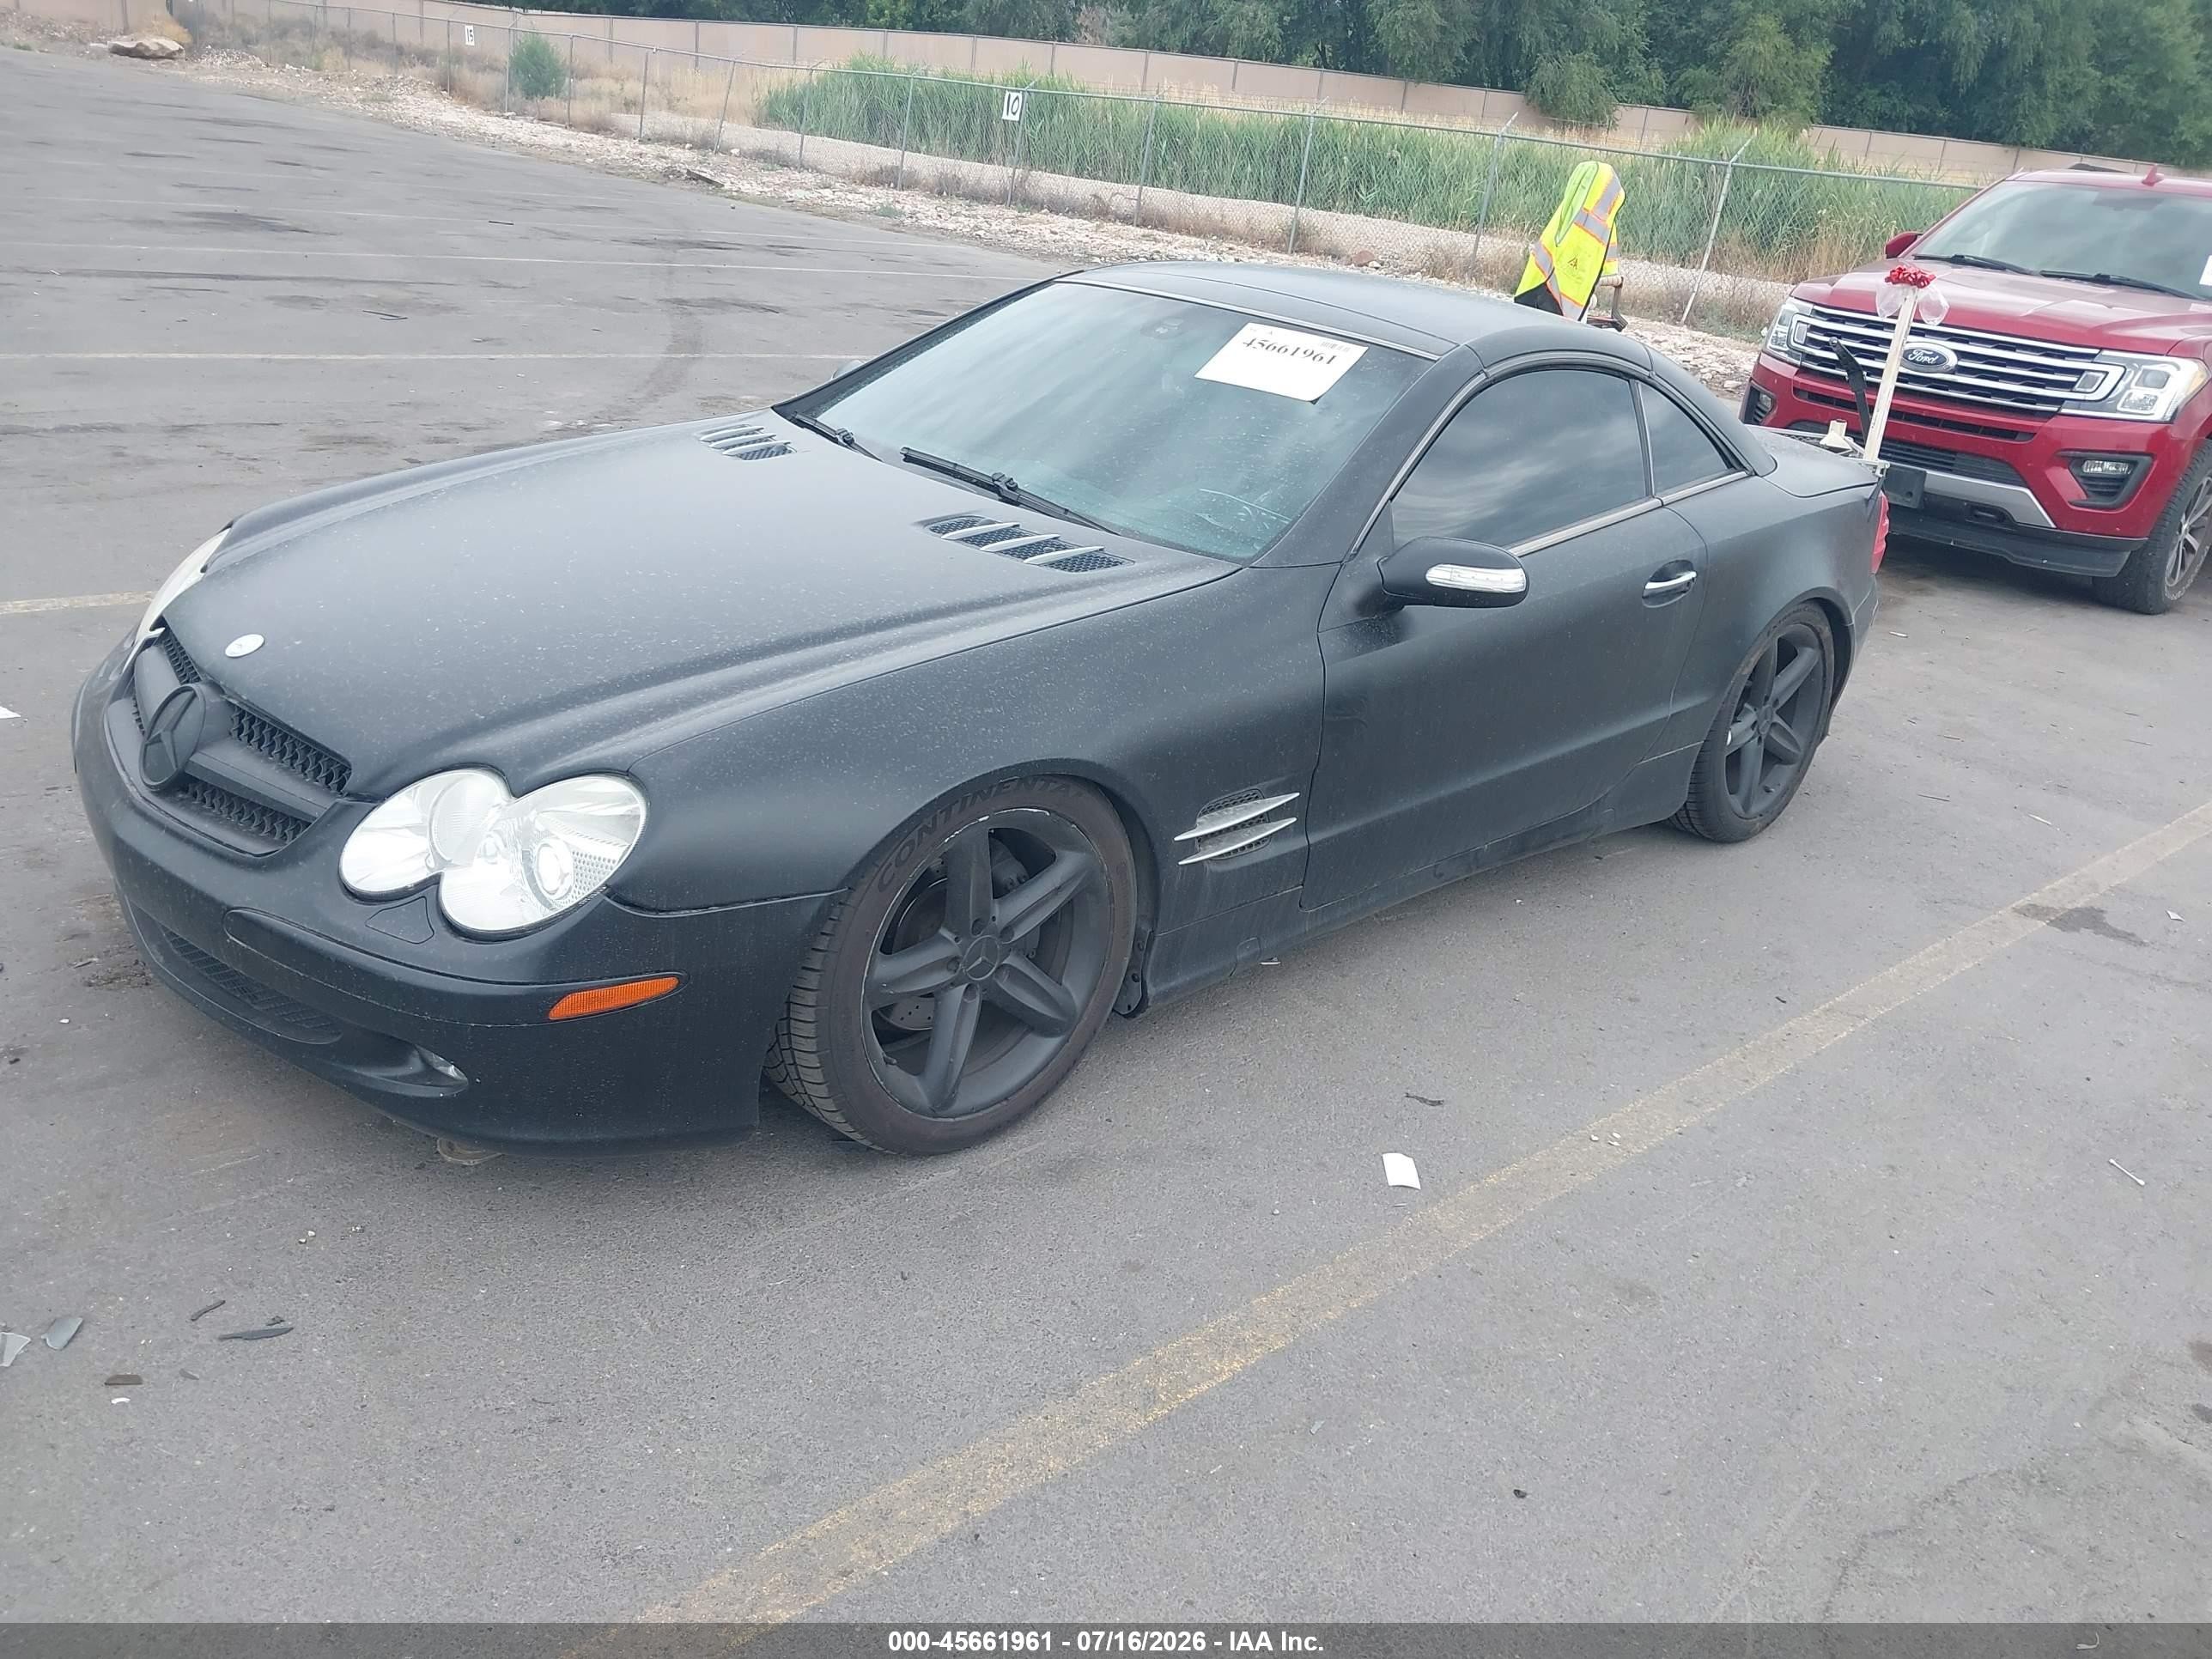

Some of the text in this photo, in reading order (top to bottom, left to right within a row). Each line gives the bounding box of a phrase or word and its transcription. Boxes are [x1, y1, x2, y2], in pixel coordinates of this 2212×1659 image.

[1006, 93, 1020, 116] 10
[1243, 338, 1337, 365] 45661961
[1907, 349, 1939, 364] Ford
